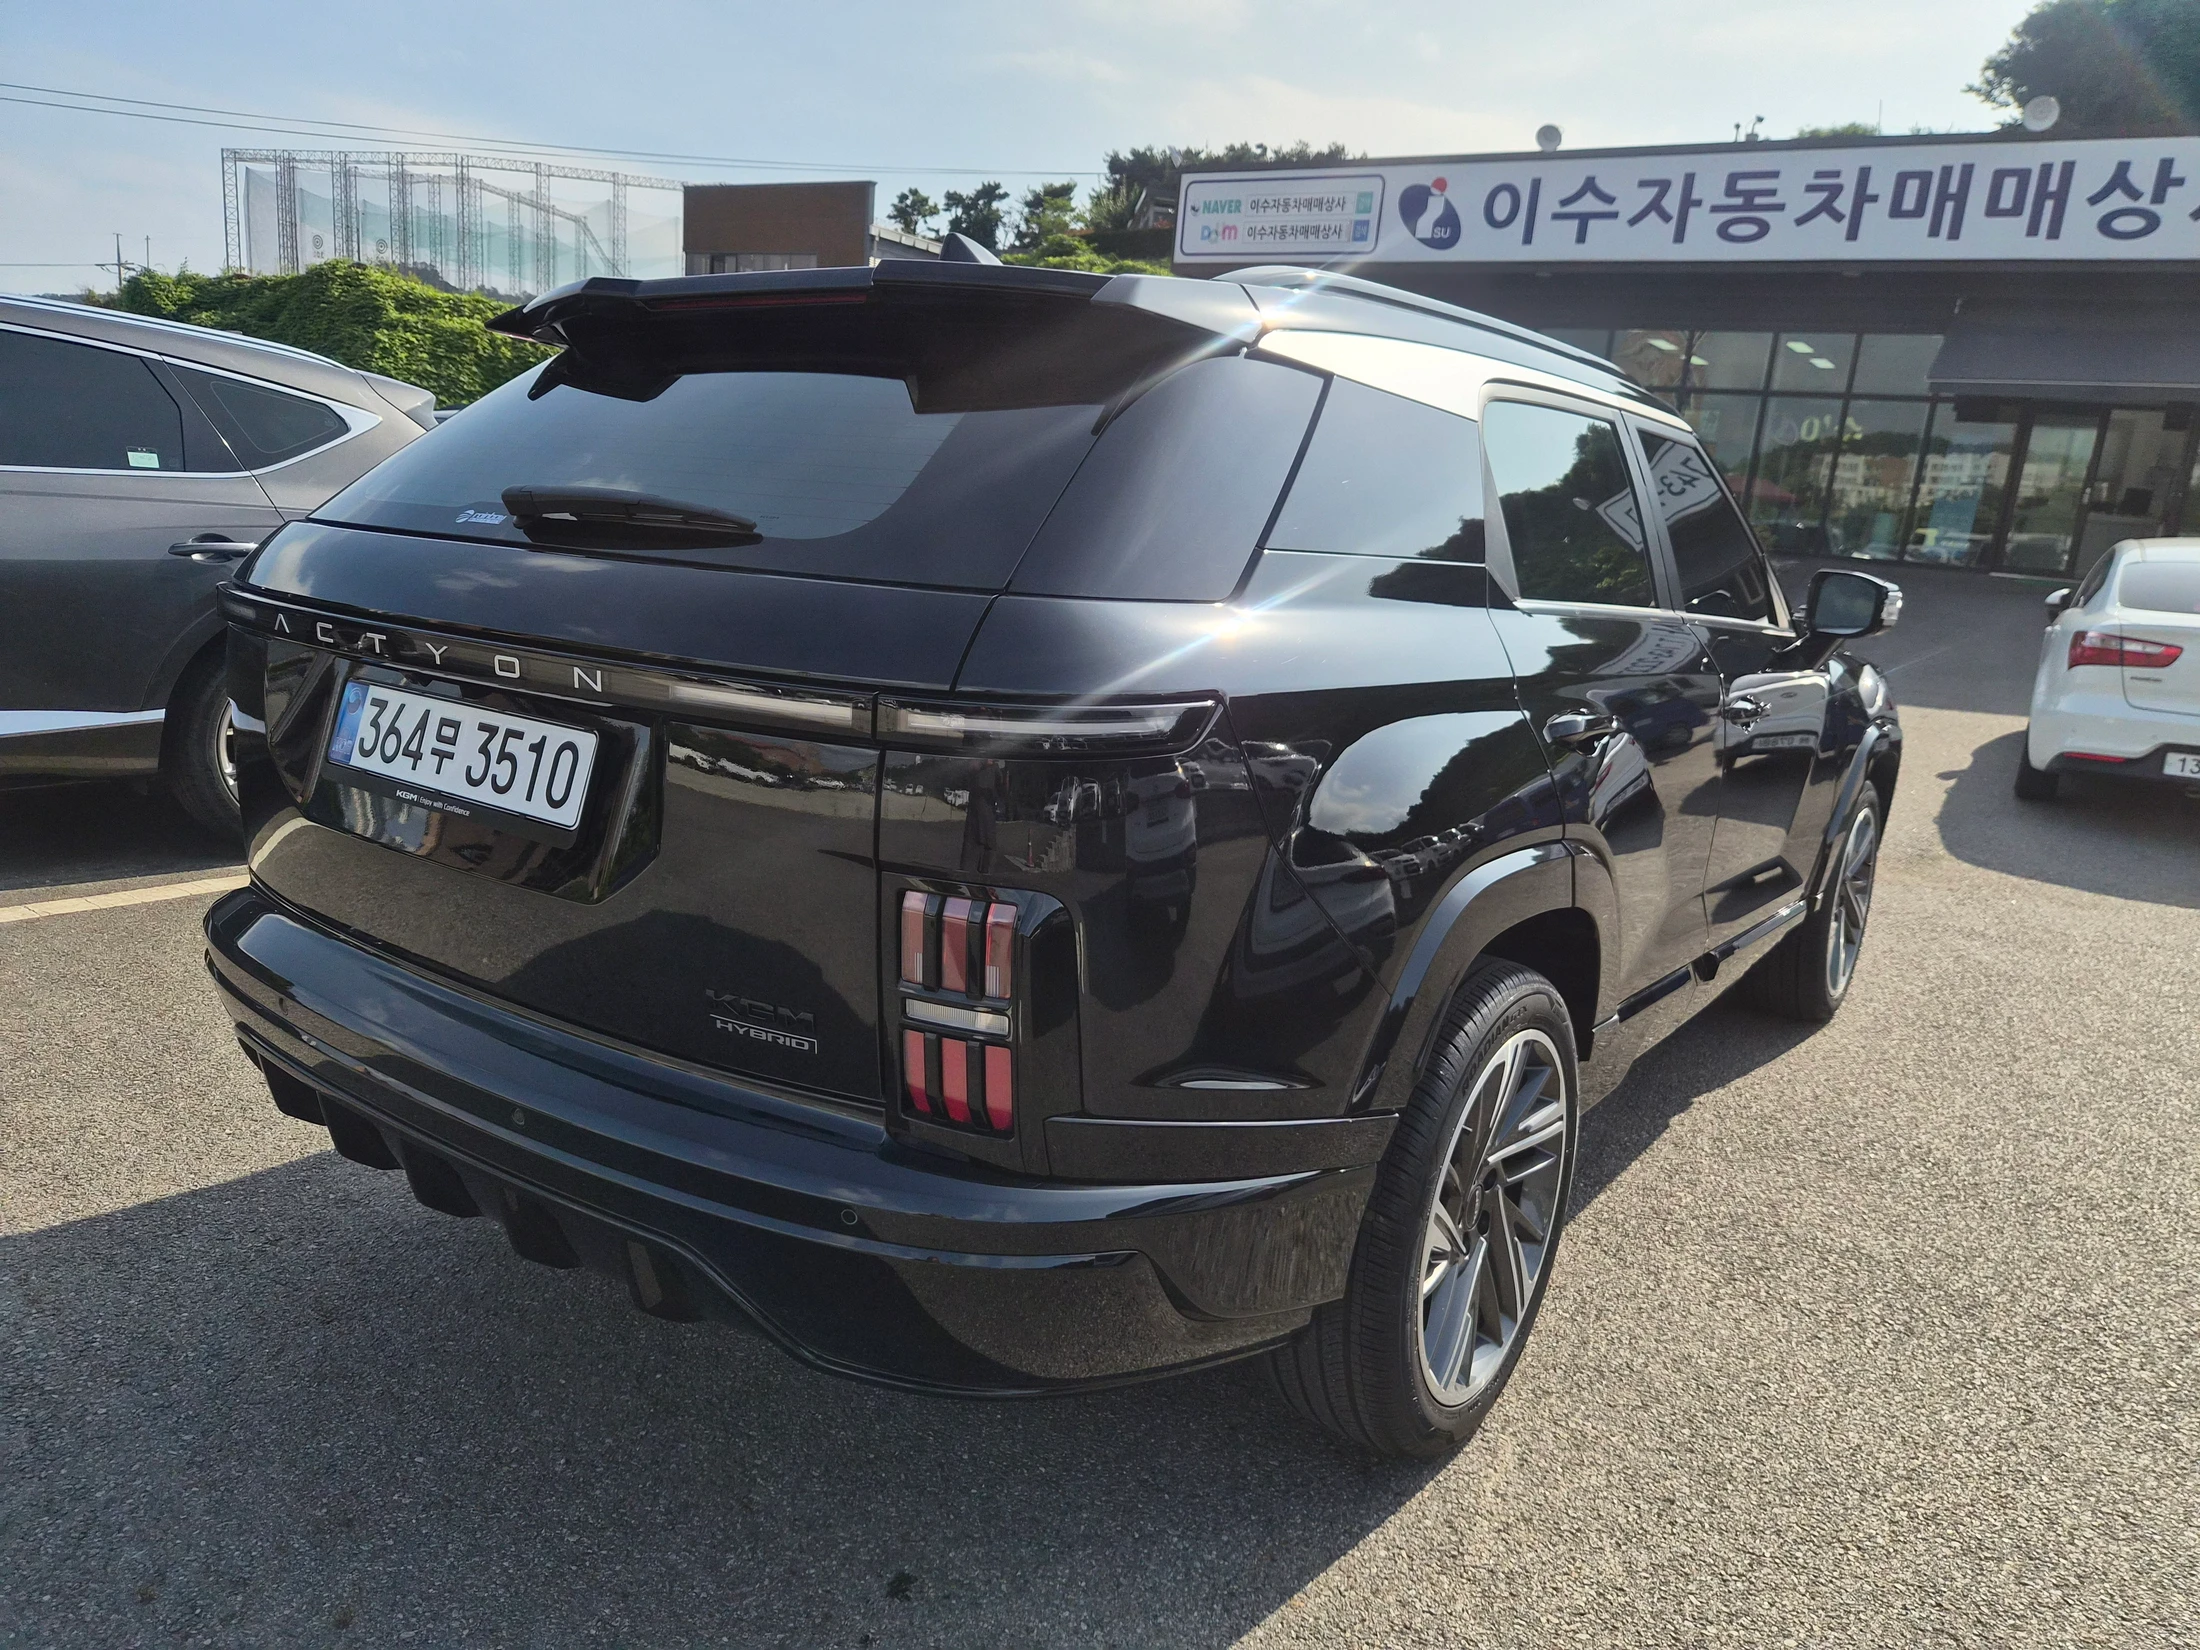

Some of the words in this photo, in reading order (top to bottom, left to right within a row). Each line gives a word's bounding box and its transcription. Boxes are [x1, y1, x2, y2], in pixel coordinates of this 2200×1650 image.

[1202, 199, 1242, 214] NAVER
[1249, 197, 1345, 214] 이수자동차매매상사
[1482, 157, 2200, 246] 이수자동차매매상
[1247, 224, 1343, 241] 이수자동차매매상사
[274, 612, 603, 693] ACTYON
[358, 697, 462, 776] 364무
[465, 721, 580, 810] 3510
[396, 789, 418, 802] KGM
[419, 796, 433, 807] Enjoy
[433, 801, 444, 810] with
[443, 803, 471, 817] Confidence
[705, 988, 815, 1034] KGM
[716, 1019, 810, 1051] HYBRID
[1461, 1013, 1511, 1097] ROADIAN
